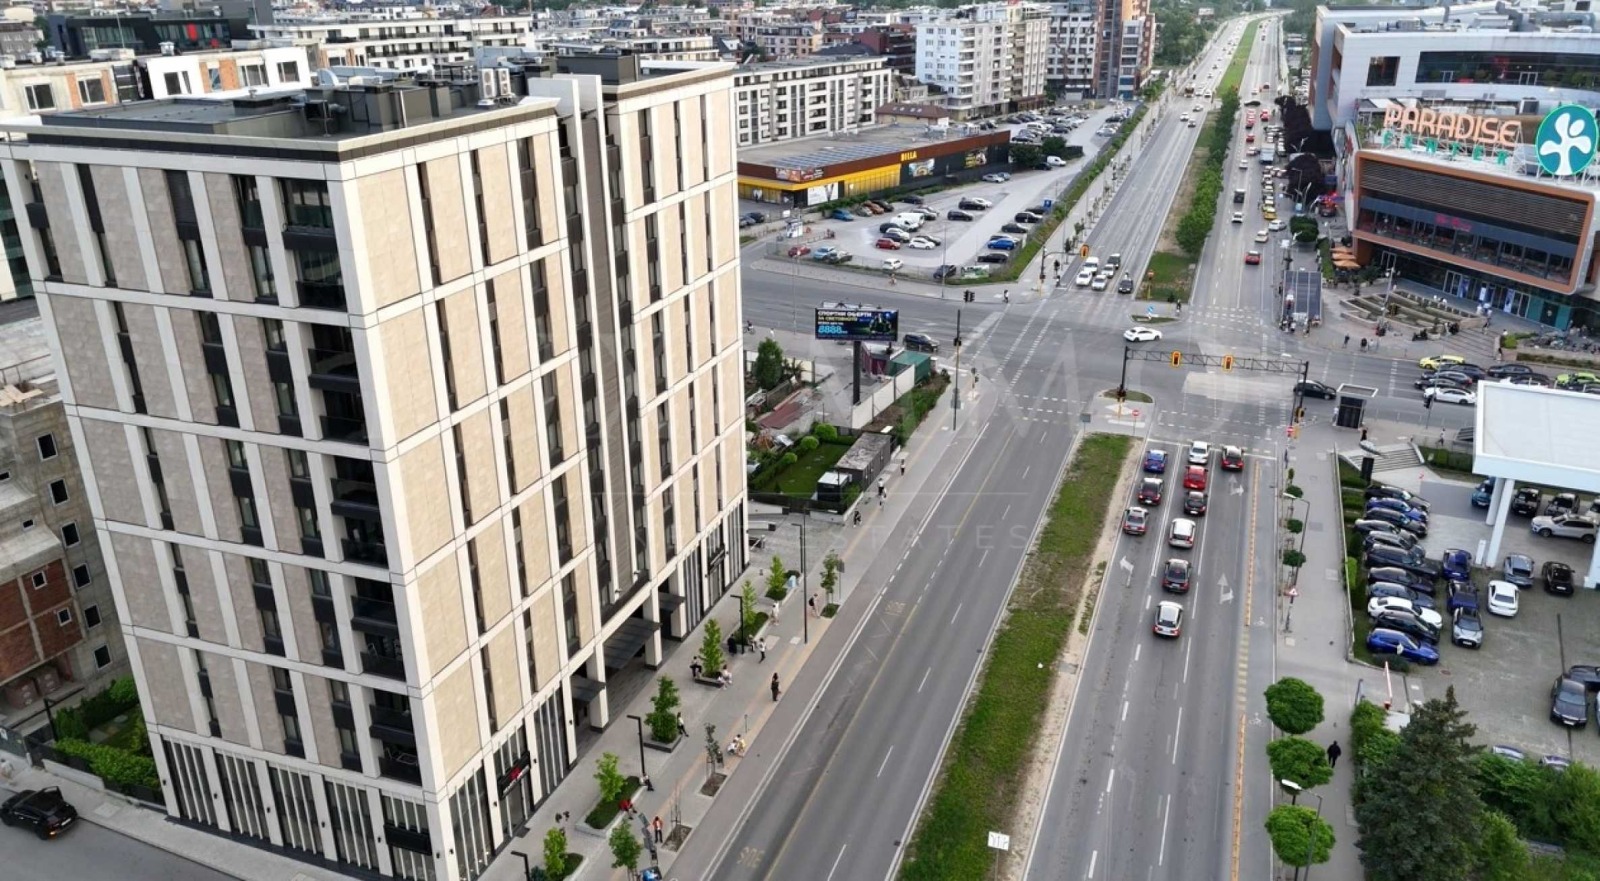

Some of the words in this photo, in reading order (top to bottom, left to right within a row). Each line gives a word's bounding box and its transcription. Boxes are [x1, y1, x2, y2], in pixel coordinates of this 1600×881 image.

[1383, 103, 1521, 147] PARADISE
[900, 150, 918, 162] BILLA
[1382, 129, 1510, 166] CENTER
